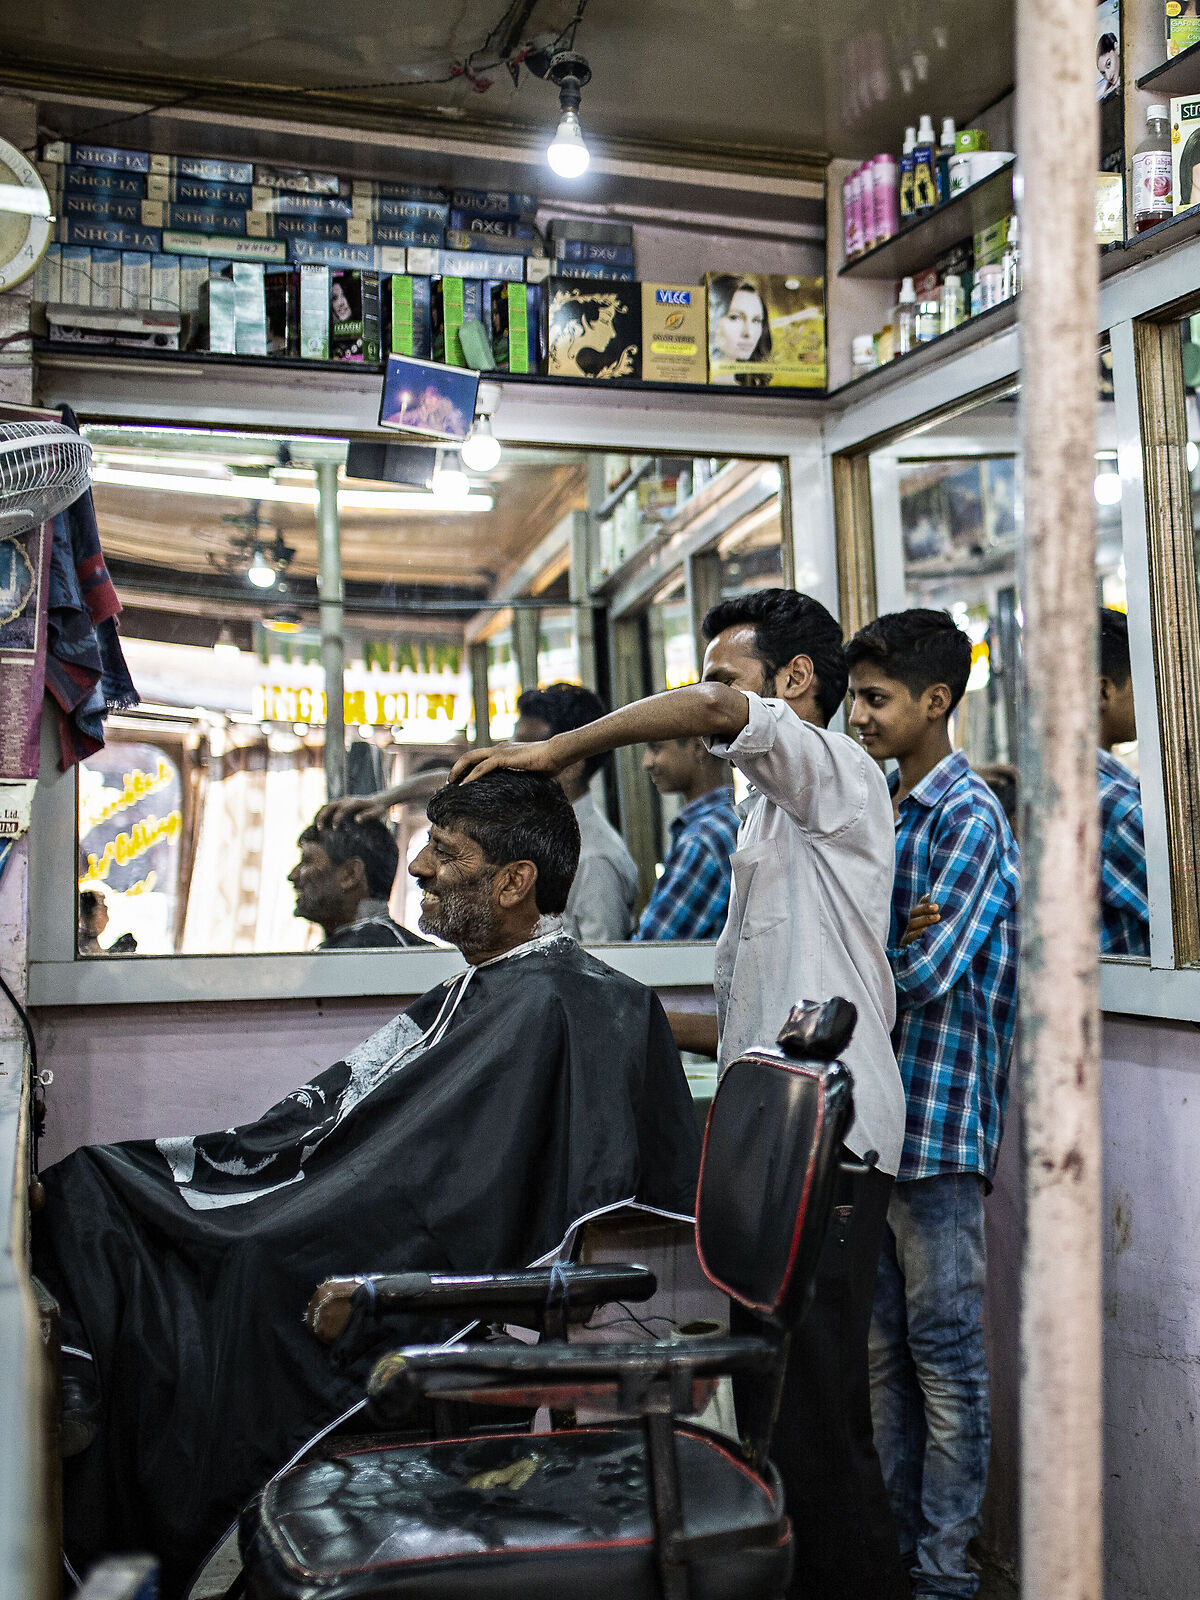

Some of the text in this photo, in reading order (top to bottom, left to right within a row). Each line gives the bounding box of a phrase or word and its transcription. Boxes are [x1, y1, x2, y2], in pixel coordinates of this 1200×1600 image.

[75, 150, 145, 168] VI-JOHN
[69, 175, 138, 192] VI-JOHN
[181, 186, 246, 203] VI-JOHN
[67, 200, 136, 217] VI-JOHN
[73, 227, 155, 246] VI-JOHN
[377, 228, 441, 244] VI-JOHN
[659, 289, 687, 305] VLCC
